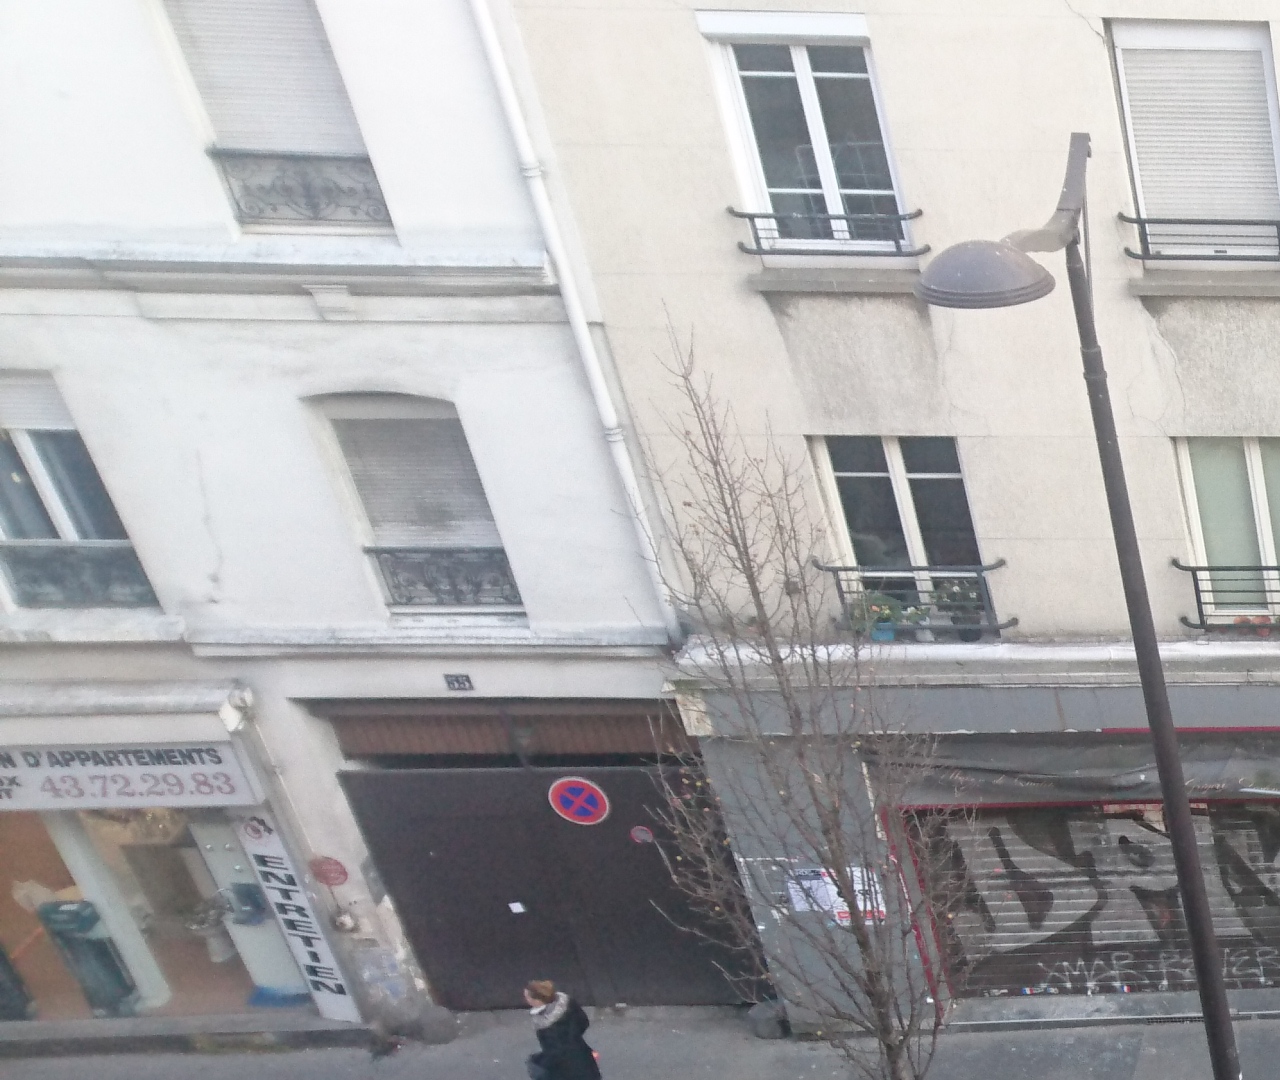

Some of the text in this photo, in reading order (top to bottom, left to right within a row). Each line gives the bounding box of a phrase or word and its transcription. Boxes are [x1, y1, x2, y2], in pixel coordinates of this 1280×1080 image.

[22, 747, 223, 768] D'APPARTEMENTS
[41, 772, 236, 799] 43.72.29.83
[252, 853, 347, 995] ENTRETIEN
